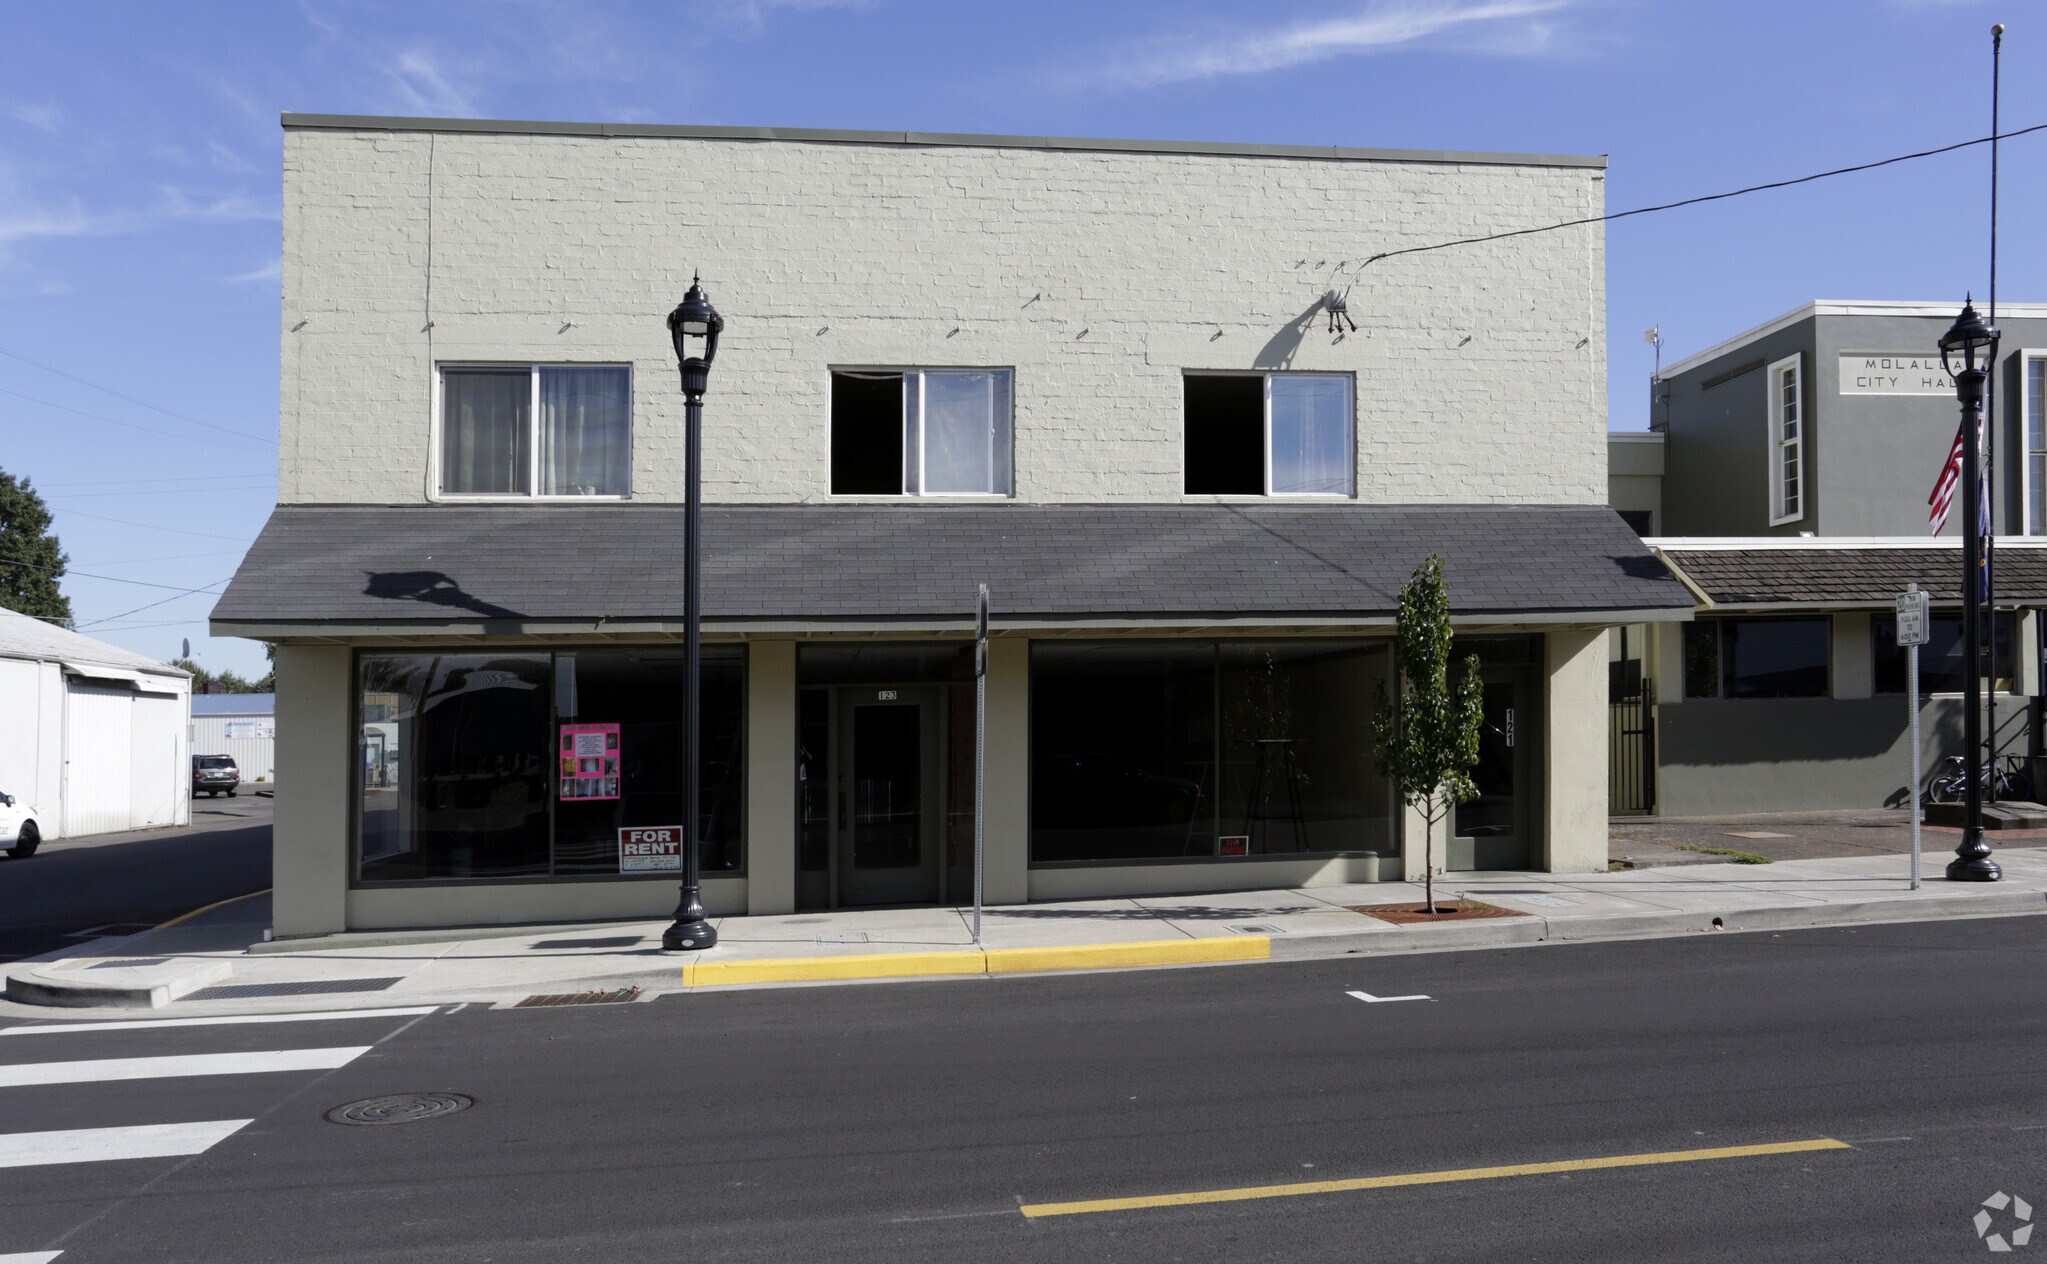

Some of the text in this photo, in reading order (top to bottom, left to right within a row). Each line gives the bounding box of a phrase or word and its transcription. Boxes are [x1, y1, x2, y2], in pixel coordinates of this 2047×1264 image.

[1865, 359, 1962, 369] MOLALLA
[1857, 376, 1957, 388] CITY HAL
[1904, 602, 1920, 610] PARKING
[880, 691, 896, 700] 123
[631, 831, 670, 842] FOR
[625, 843, 678, 855] RENT
